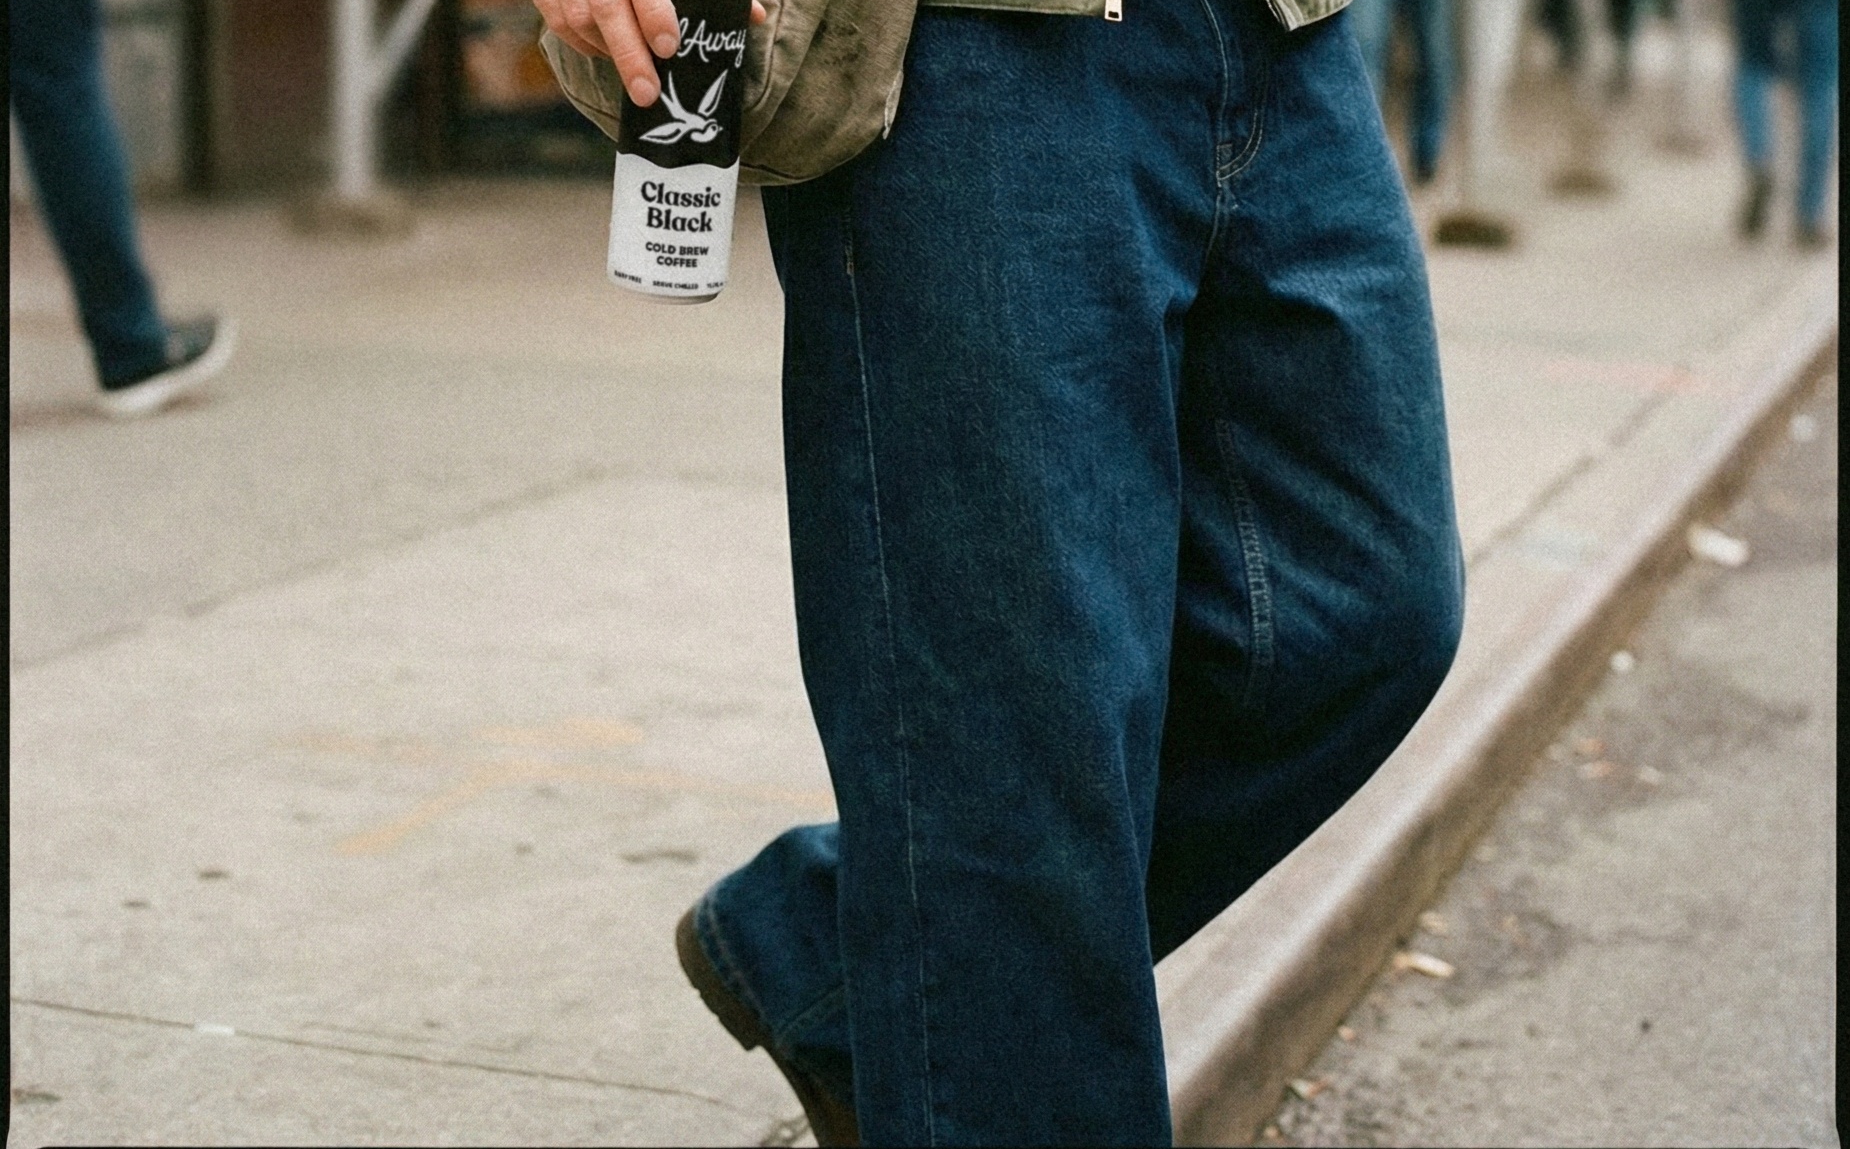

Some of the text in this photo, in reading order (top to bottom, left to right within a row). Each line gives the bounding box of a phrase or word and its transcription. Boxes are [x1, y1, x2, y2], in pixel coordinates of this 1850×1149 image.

[677, 19, 747, 69] Away
[640, 180, 721, 208] Classic
[646, 206, 713, 233] Black
[645, 241, 709, 256] COLD BREW
[656, 255, 698, 268] COFFEE
